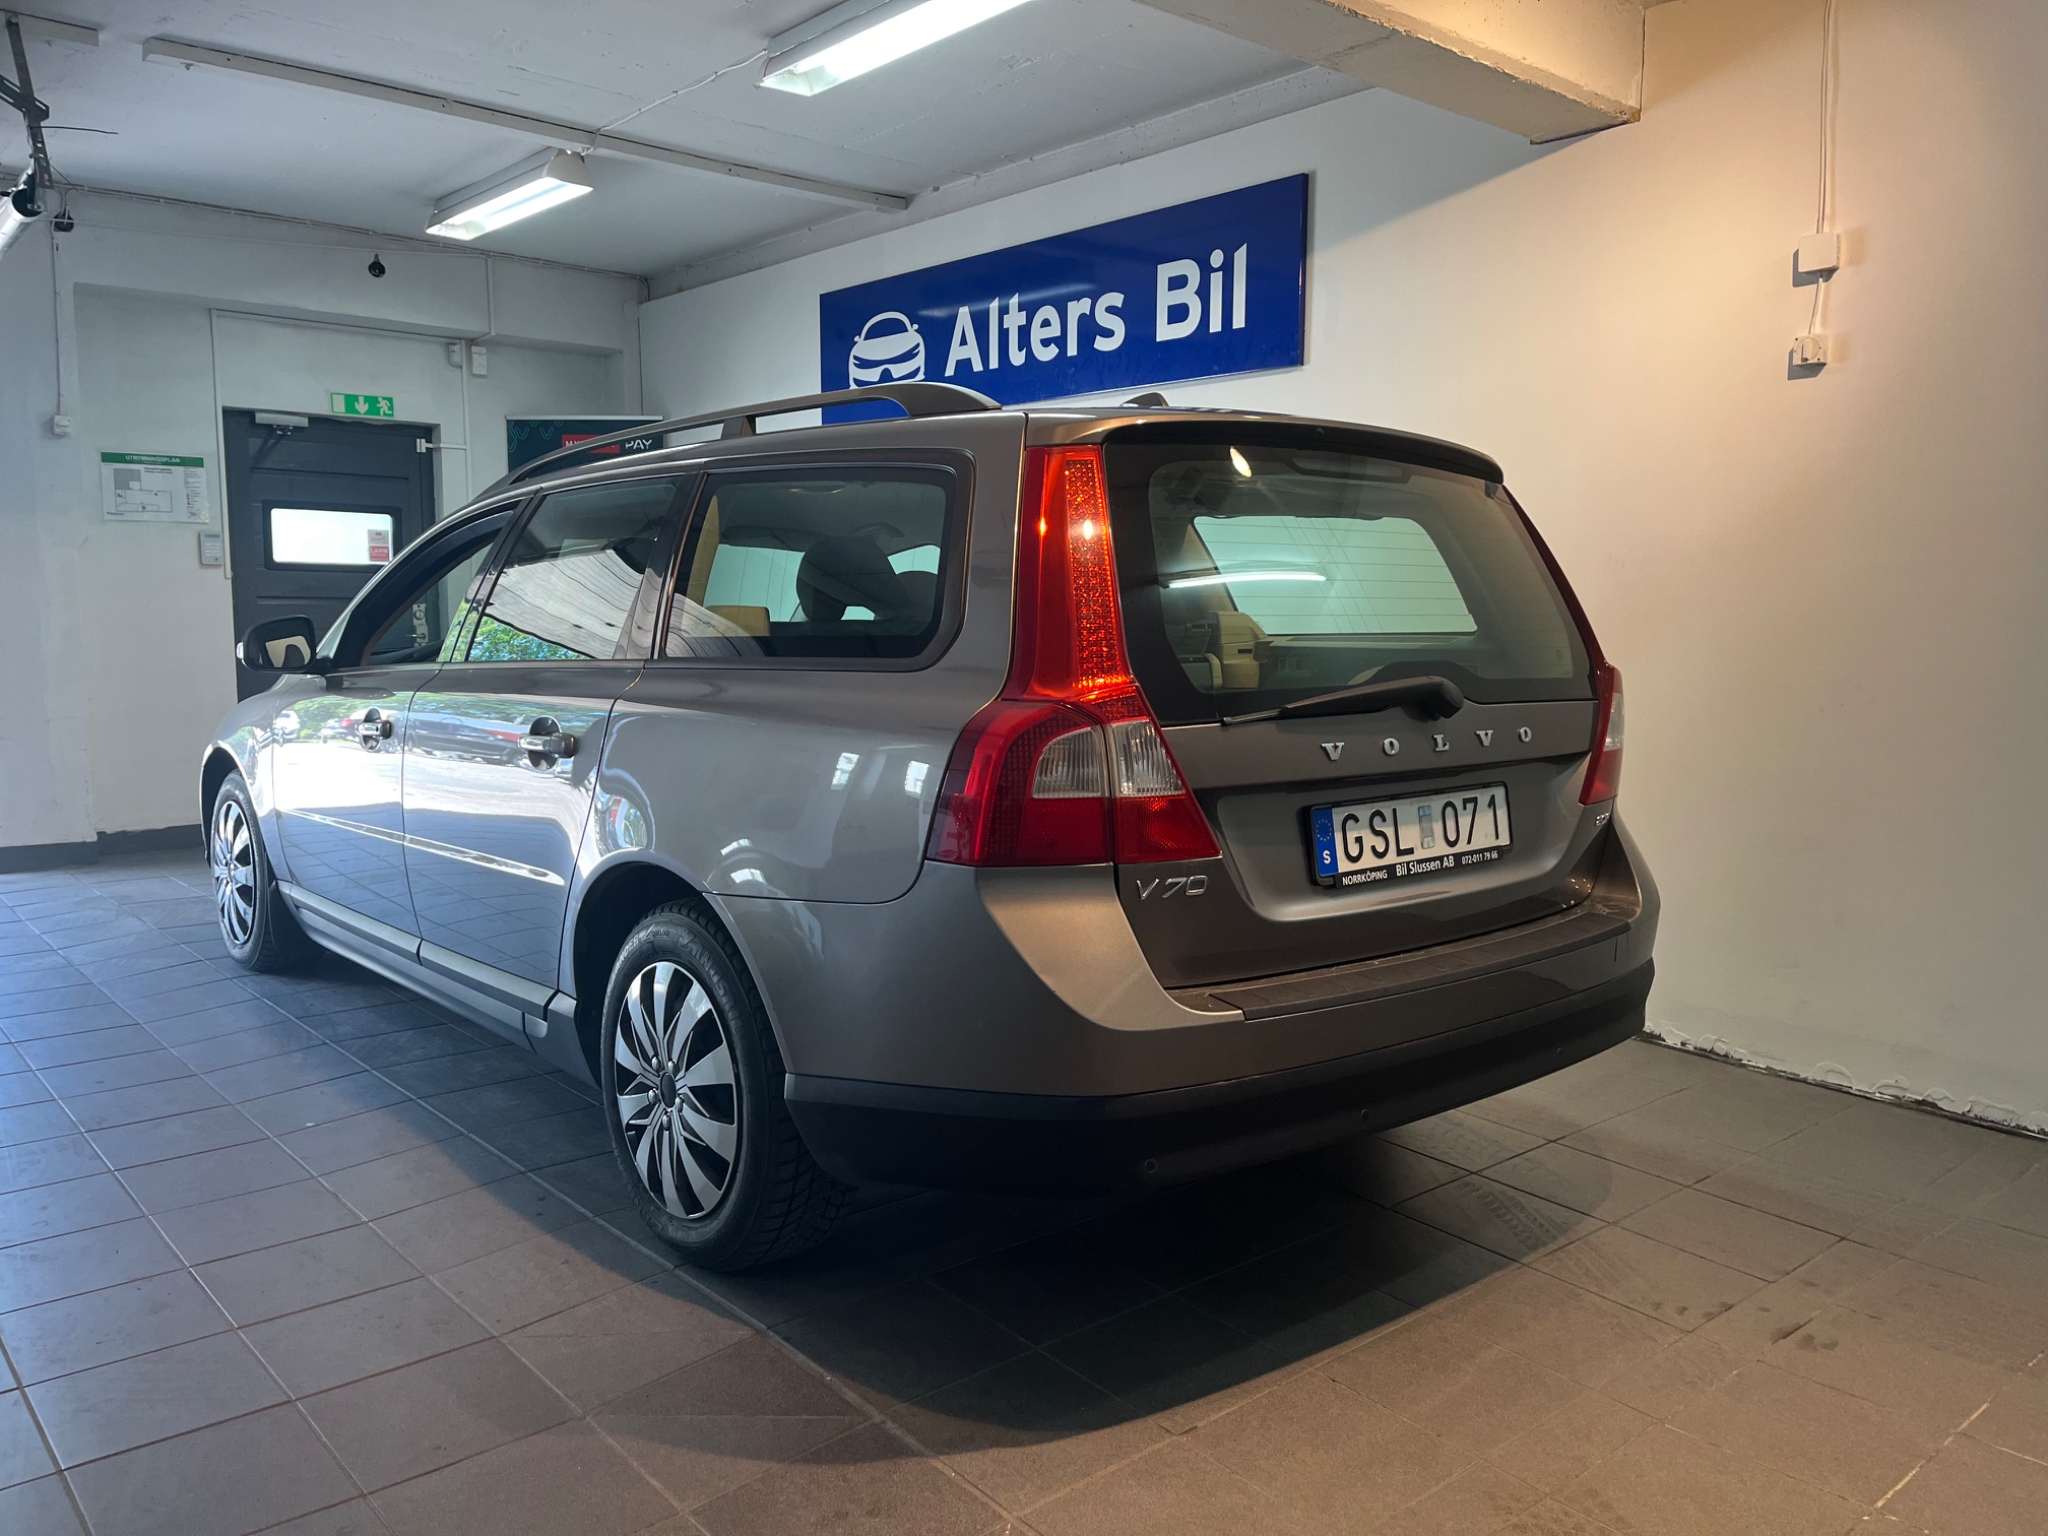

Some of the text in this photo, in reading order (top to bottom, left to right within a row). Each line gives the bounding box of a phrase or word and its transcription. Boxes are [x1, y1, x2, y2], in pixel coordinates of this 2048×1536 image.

[945, 242, 1248, 377] Alters Bil
[625, 439, 652, 450] PAY
[1321, 726, 1532, 761] VOLVO
[1341, 793, 1500, 863] GSL 071
[1322, 850, 1332, 865] S
[1342, 869, 1388, 886] NORRKÖPING
[1396, 863, 1408, 877] Bil
[1410, 860, 1441, 875] Slussen
[1442, 856, 1455, 869] AB
[1461, 853, 1483, 865] 072-011
[1483, 851, 1491, 862] 79
[1136, 875, 1208, 900] V70
